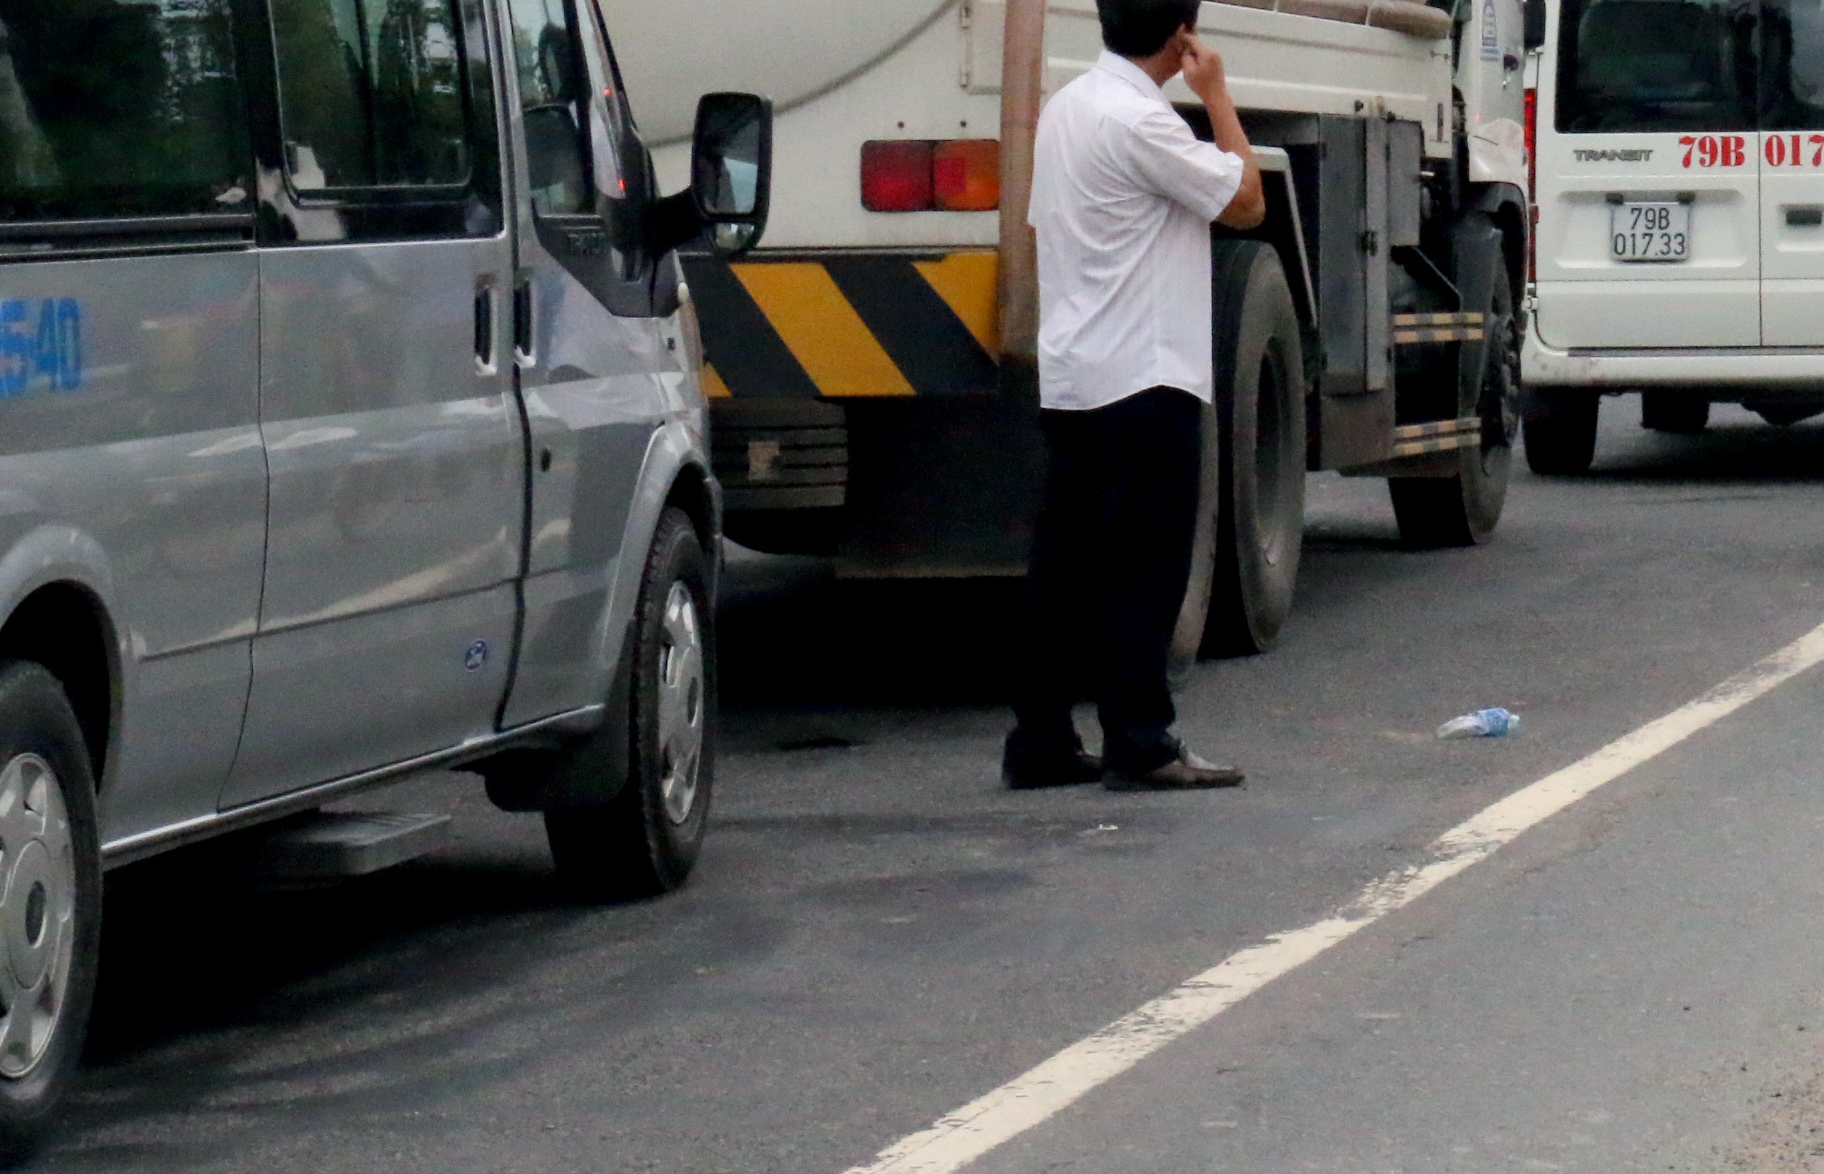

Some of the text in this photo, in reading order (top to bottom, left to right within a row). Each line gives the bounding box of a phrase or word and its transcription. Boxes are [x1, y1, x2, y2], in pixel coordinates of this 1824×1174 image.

[1678, 136, 1745, 168] 79B
[1630, 207, 1670, 230] 79B
[1613, 232, 1686, 256] 017.33
